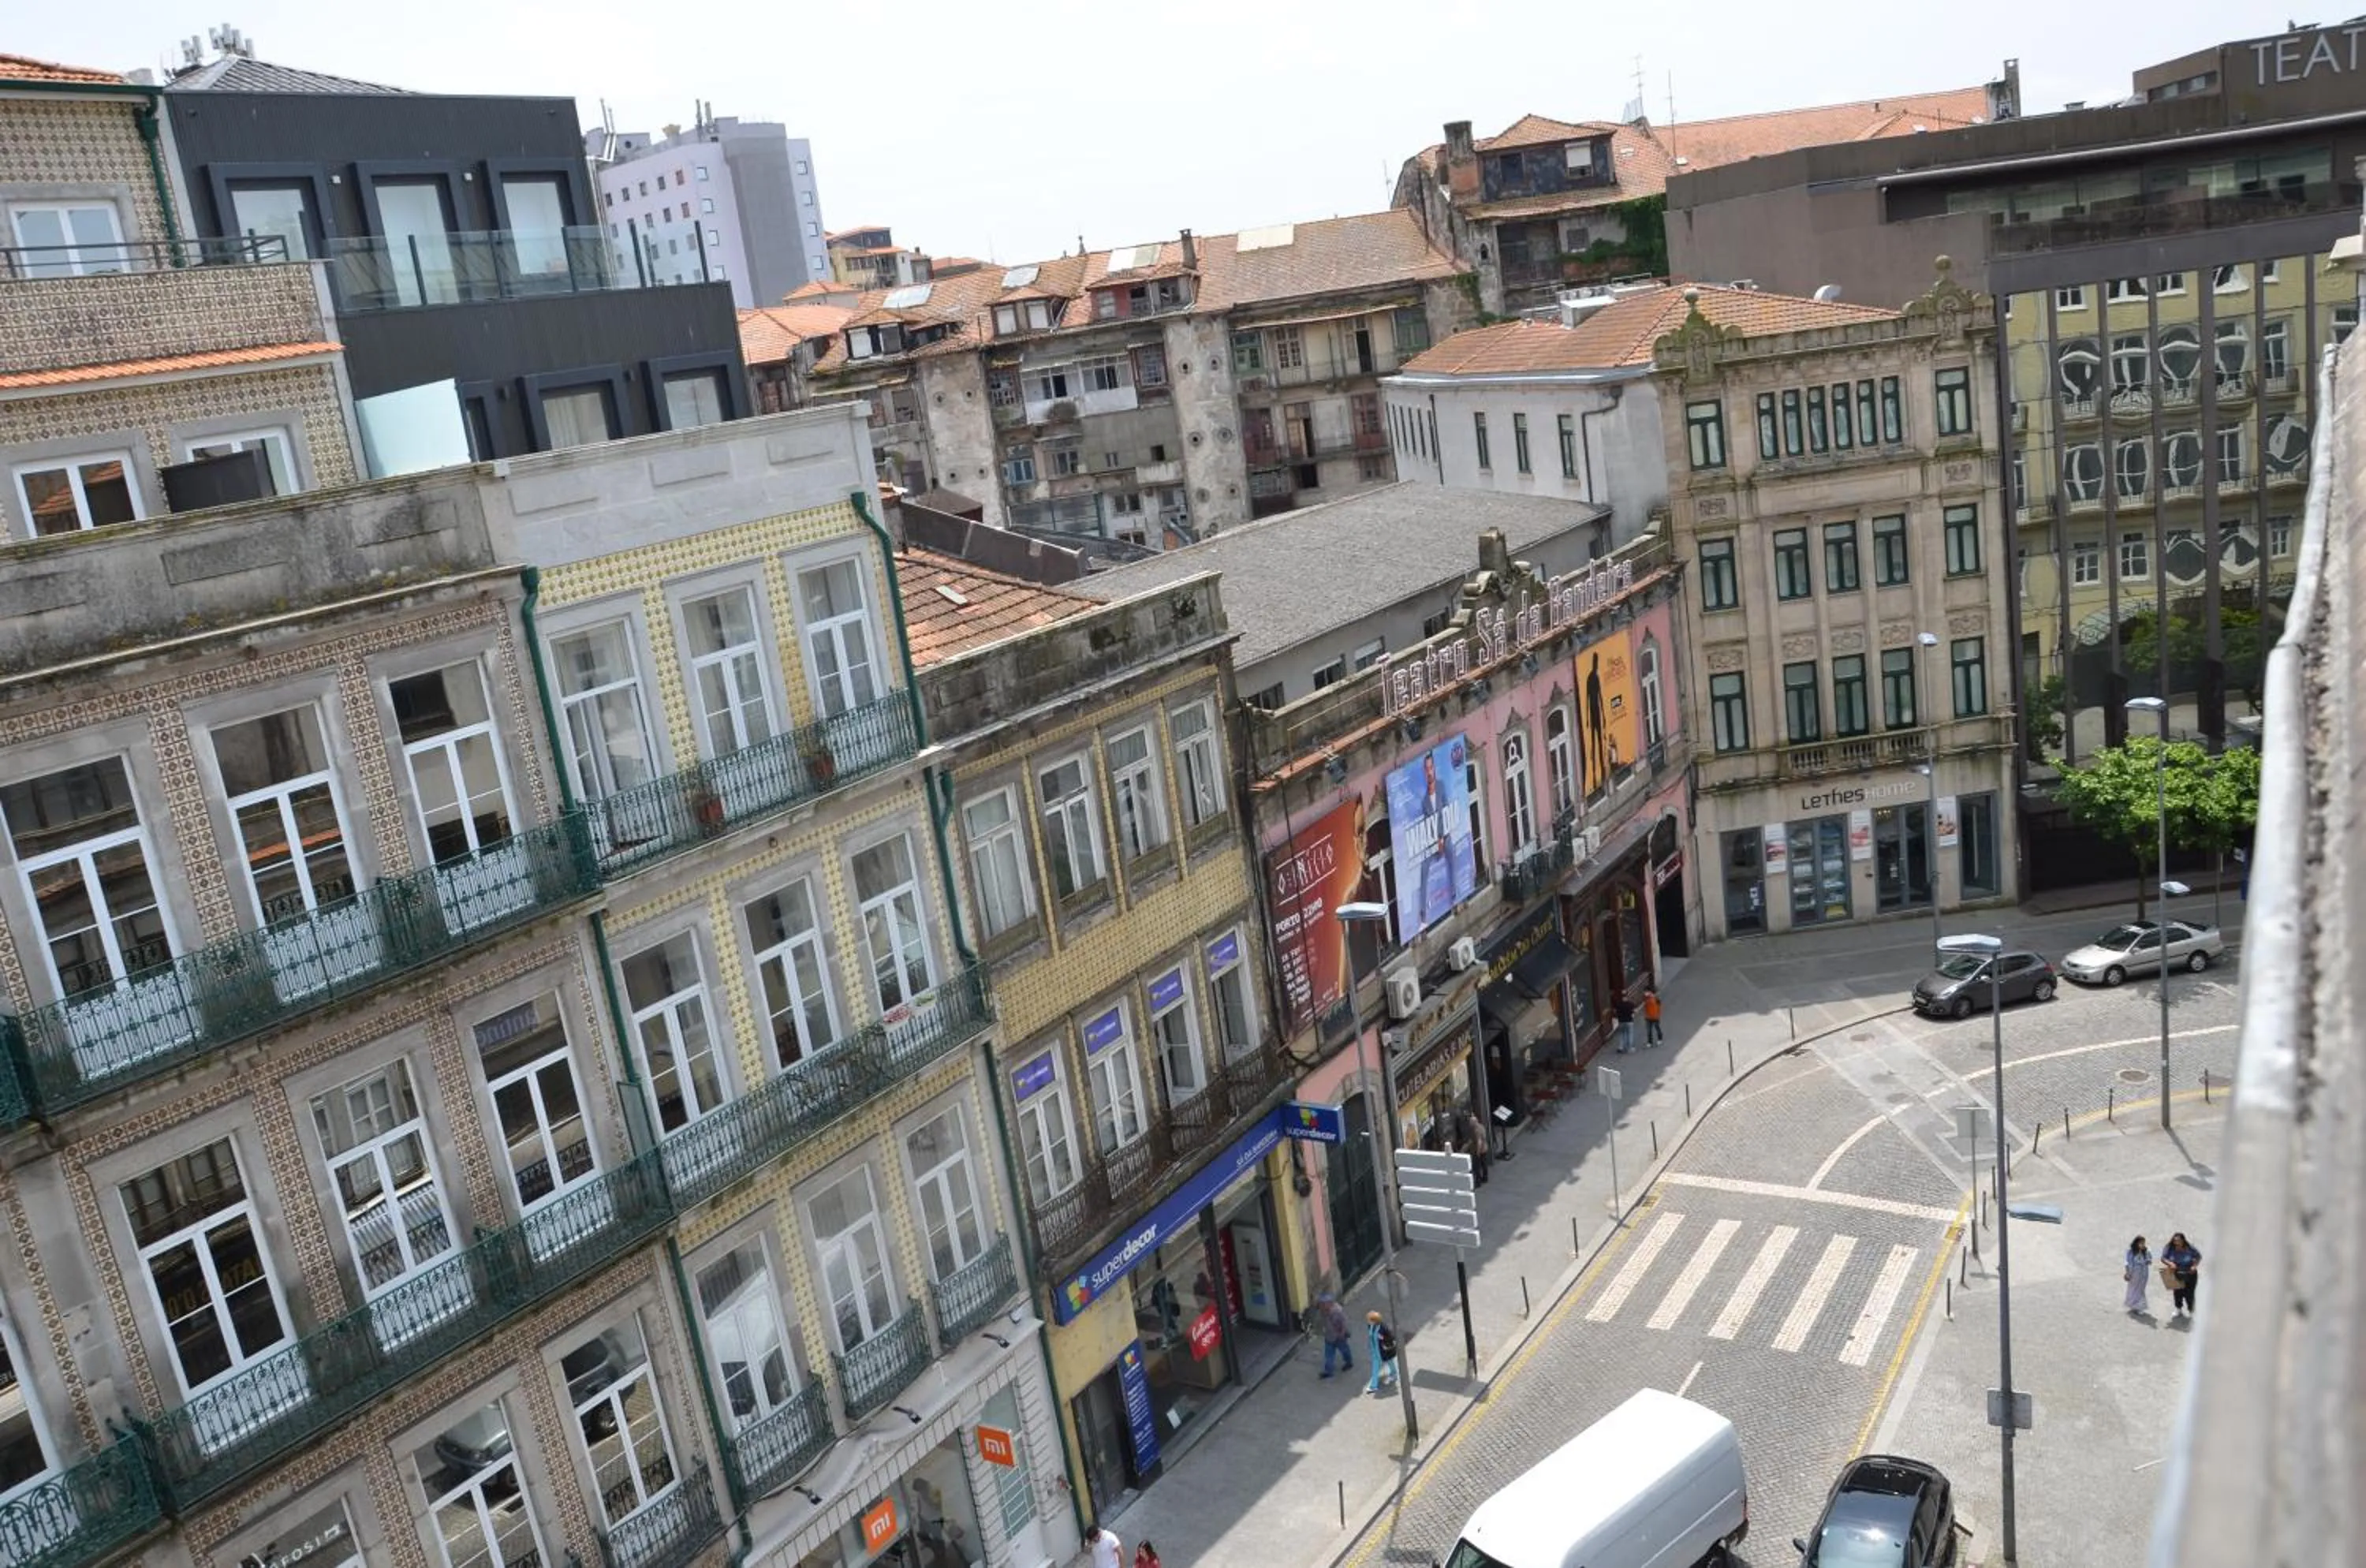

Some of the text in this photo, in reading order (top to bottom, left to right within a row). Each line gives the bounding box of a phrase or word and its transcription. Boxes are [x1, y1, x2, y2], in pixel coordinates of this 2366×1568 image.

[2249, 27, 2366, 85] TEAT
[1375, 638, 1468, 717] Teatro
[1516, 590, 1541, 648] da
[1547, 558, 1633, 631] Bandeira
[1091, 1223, 1157, 1288] superdecor
